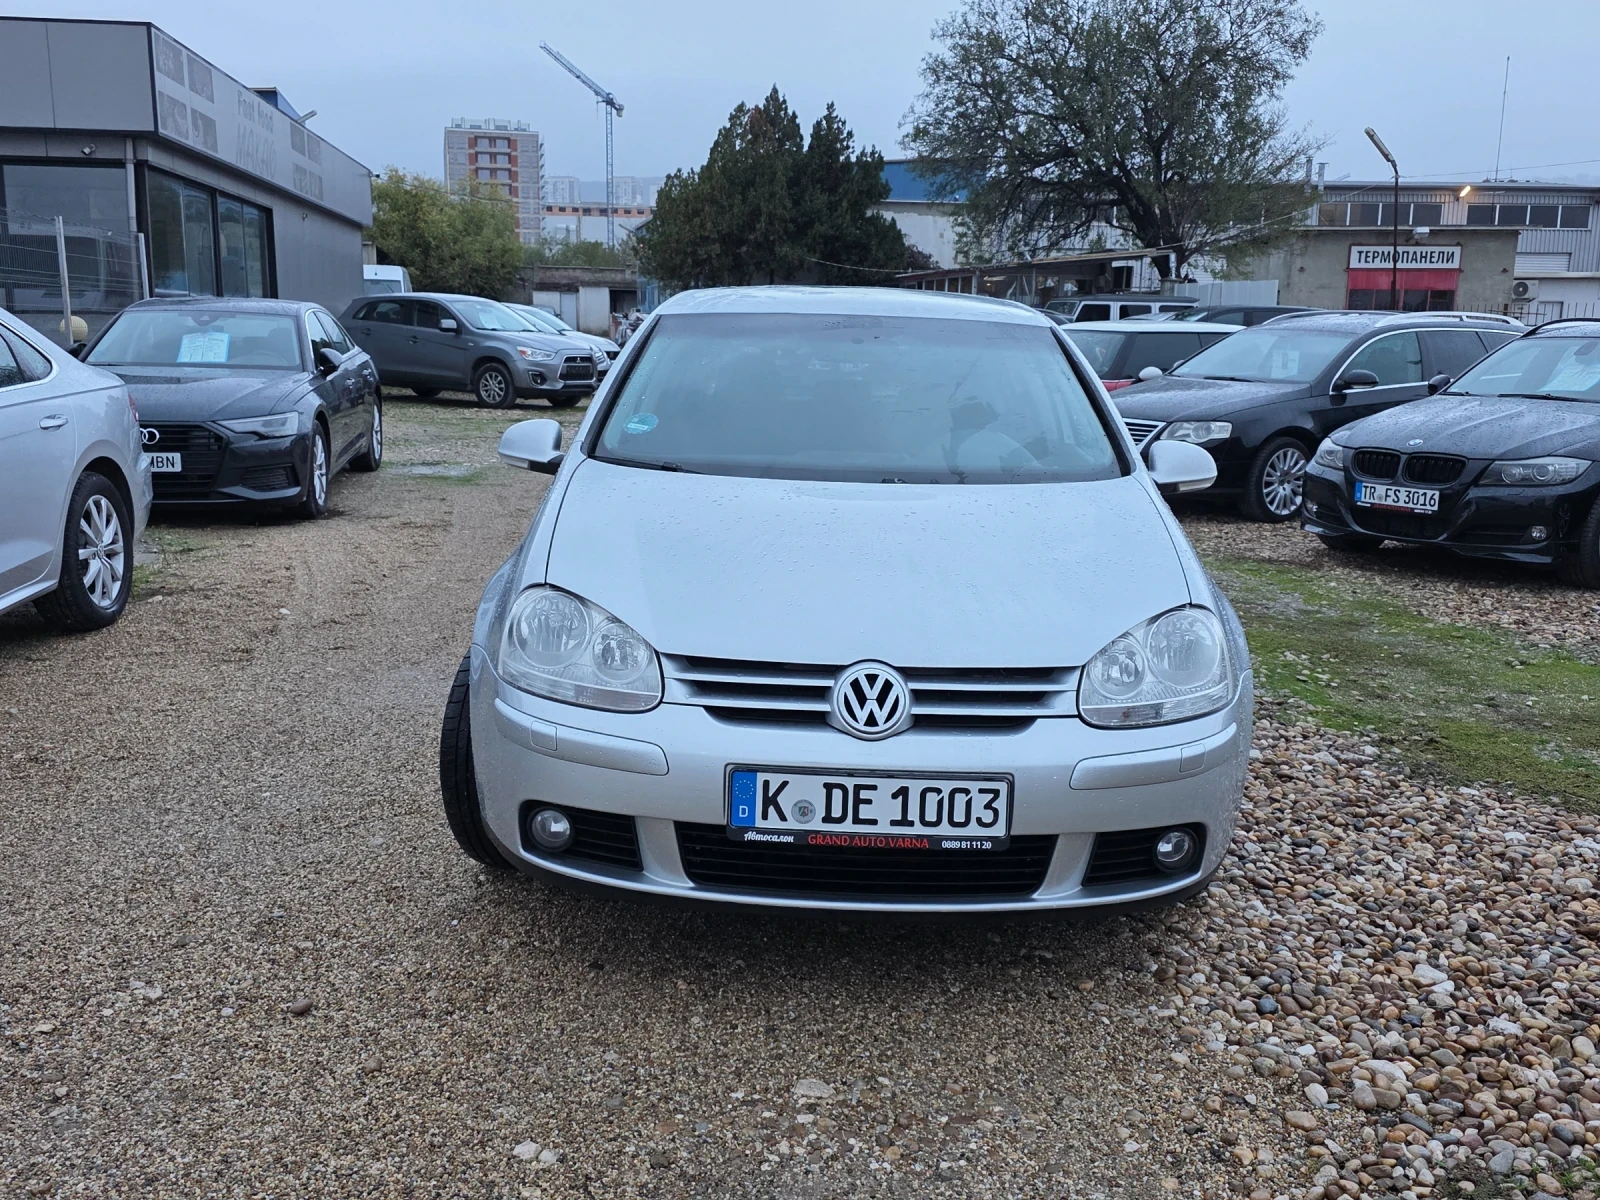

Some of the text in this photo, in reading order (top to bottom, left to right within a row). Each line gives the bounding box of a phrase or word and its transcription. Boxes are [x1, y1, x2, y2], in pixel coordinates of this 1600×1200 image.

[1357, 250, 1455, 264] ТЕРМОПАНЕЛИ
[1362, 485, 1377, 501] TR
[1384, 488, 1401, 504] FS
[1403, 489, 1437, 508] 3016
[738, 804, 749, 818] D
[761, 779, 790, 822] K
[821, 782, 879, 826] DE
[889, 785, 1001, 829] 1003
[743, 831, 794, 843] Автосалон
[807, 834, 930, 849] GRAND AUTO VARNA
[941, 840, 960, 849] 0889
